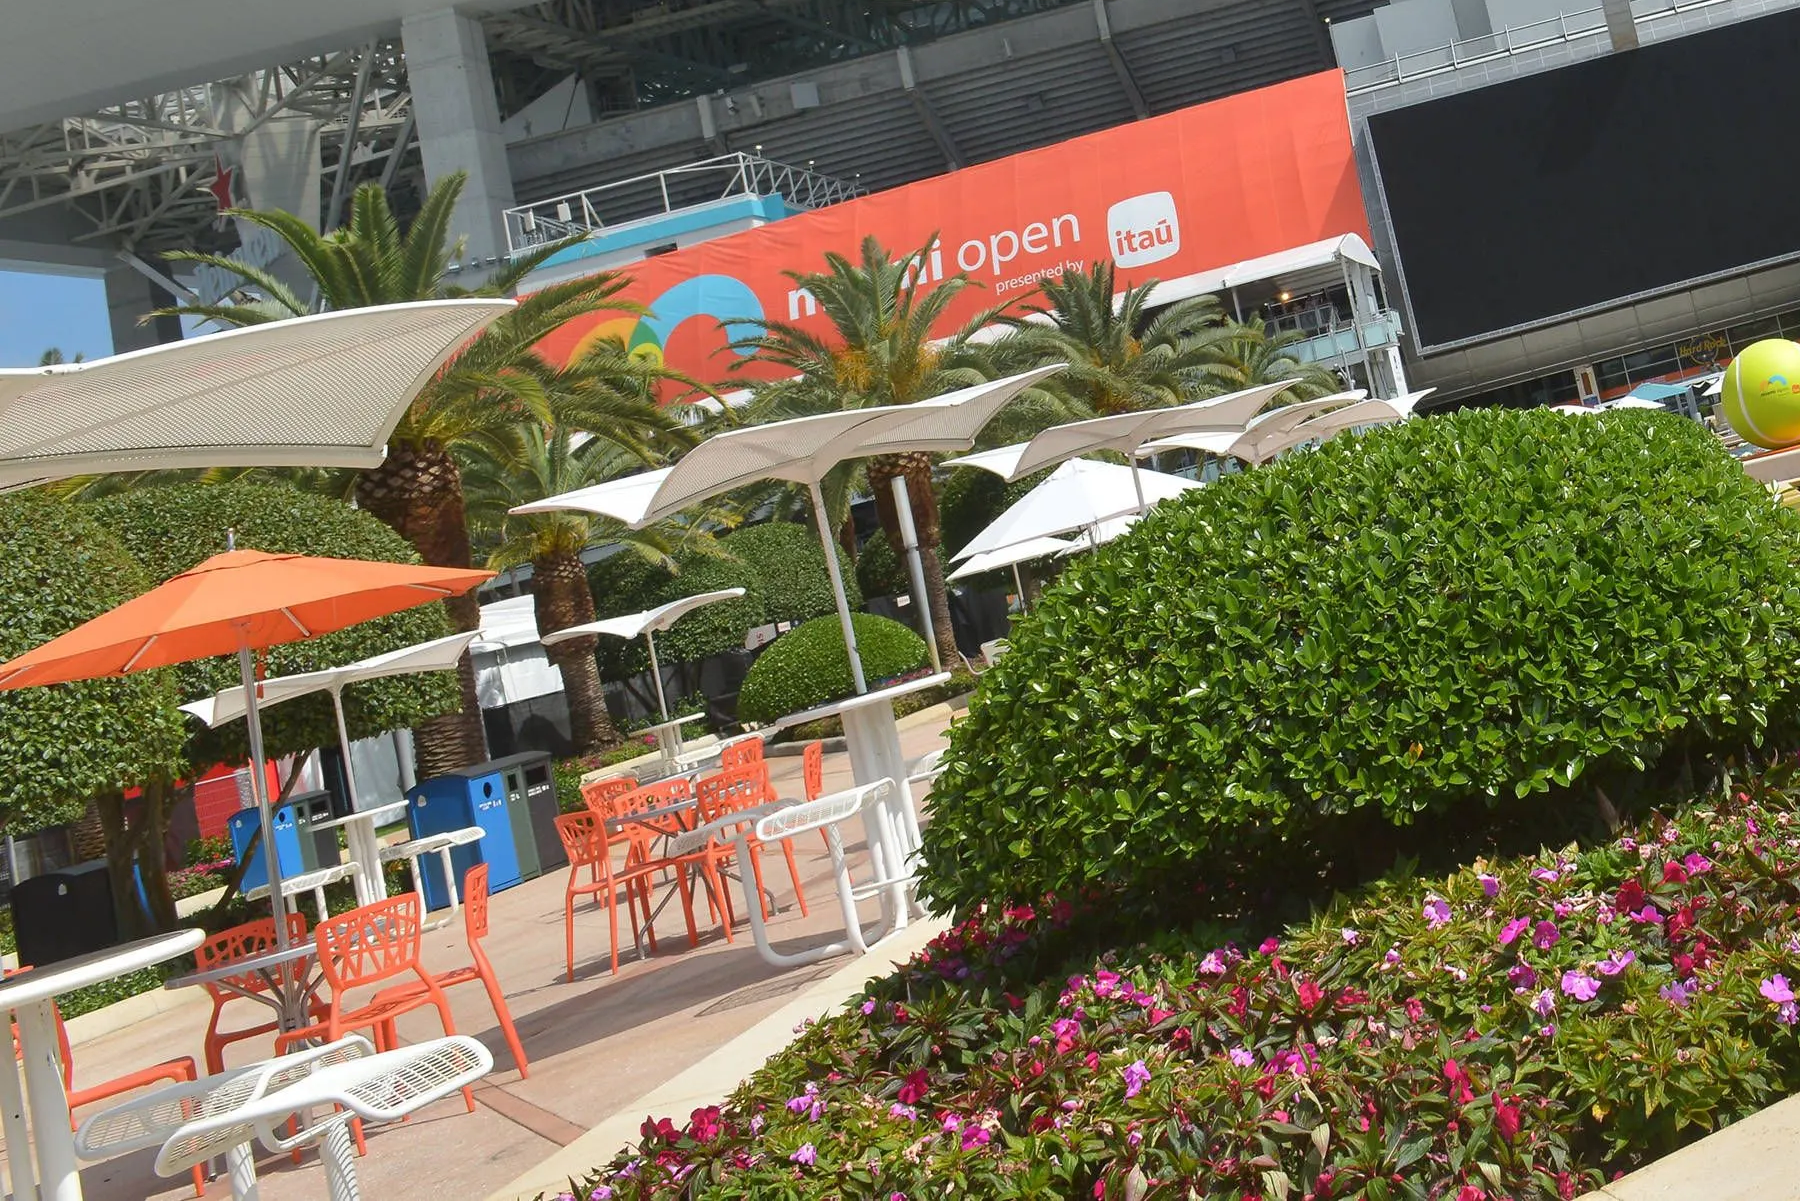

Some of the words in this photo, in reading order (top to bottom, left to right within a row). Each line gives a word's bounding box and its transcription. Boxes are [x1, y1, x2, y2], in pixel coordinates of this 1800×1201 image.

[957, 213, 1081, 275] open
[1115, 219, 1173, 256] itaú
[995, 262, 1064, 296] presented
